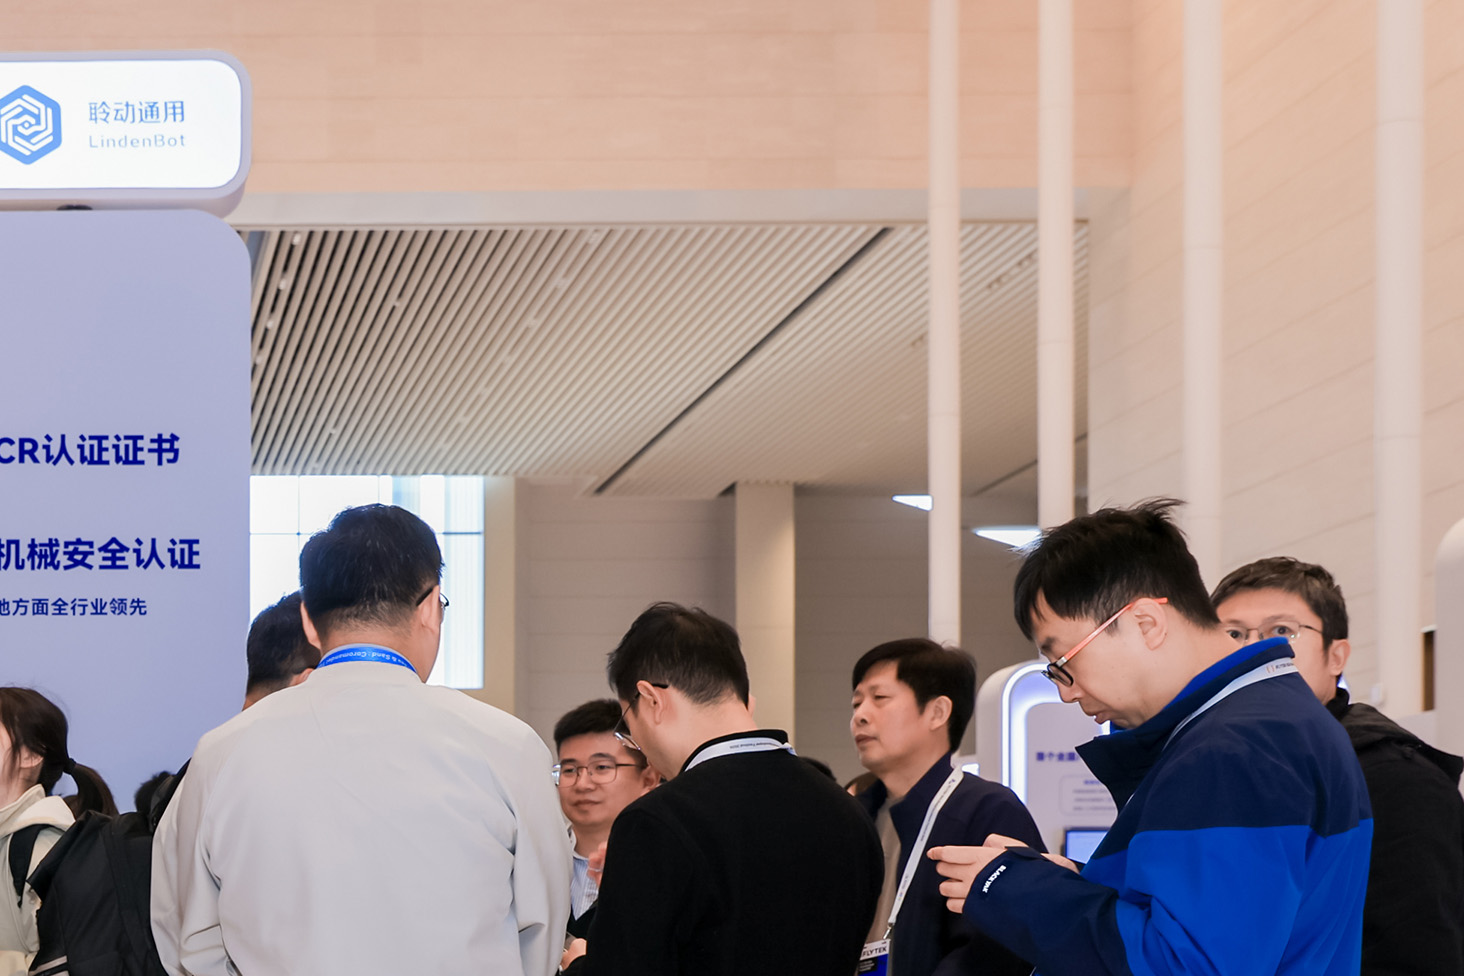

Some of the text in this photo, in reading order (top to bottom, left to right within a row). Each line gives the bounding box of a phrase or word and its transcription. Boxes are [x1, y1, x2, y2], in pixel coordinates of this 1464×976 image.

[88, 100, 186, 124] 聆动通用
[88, 133, 186, 149] LindenBot
